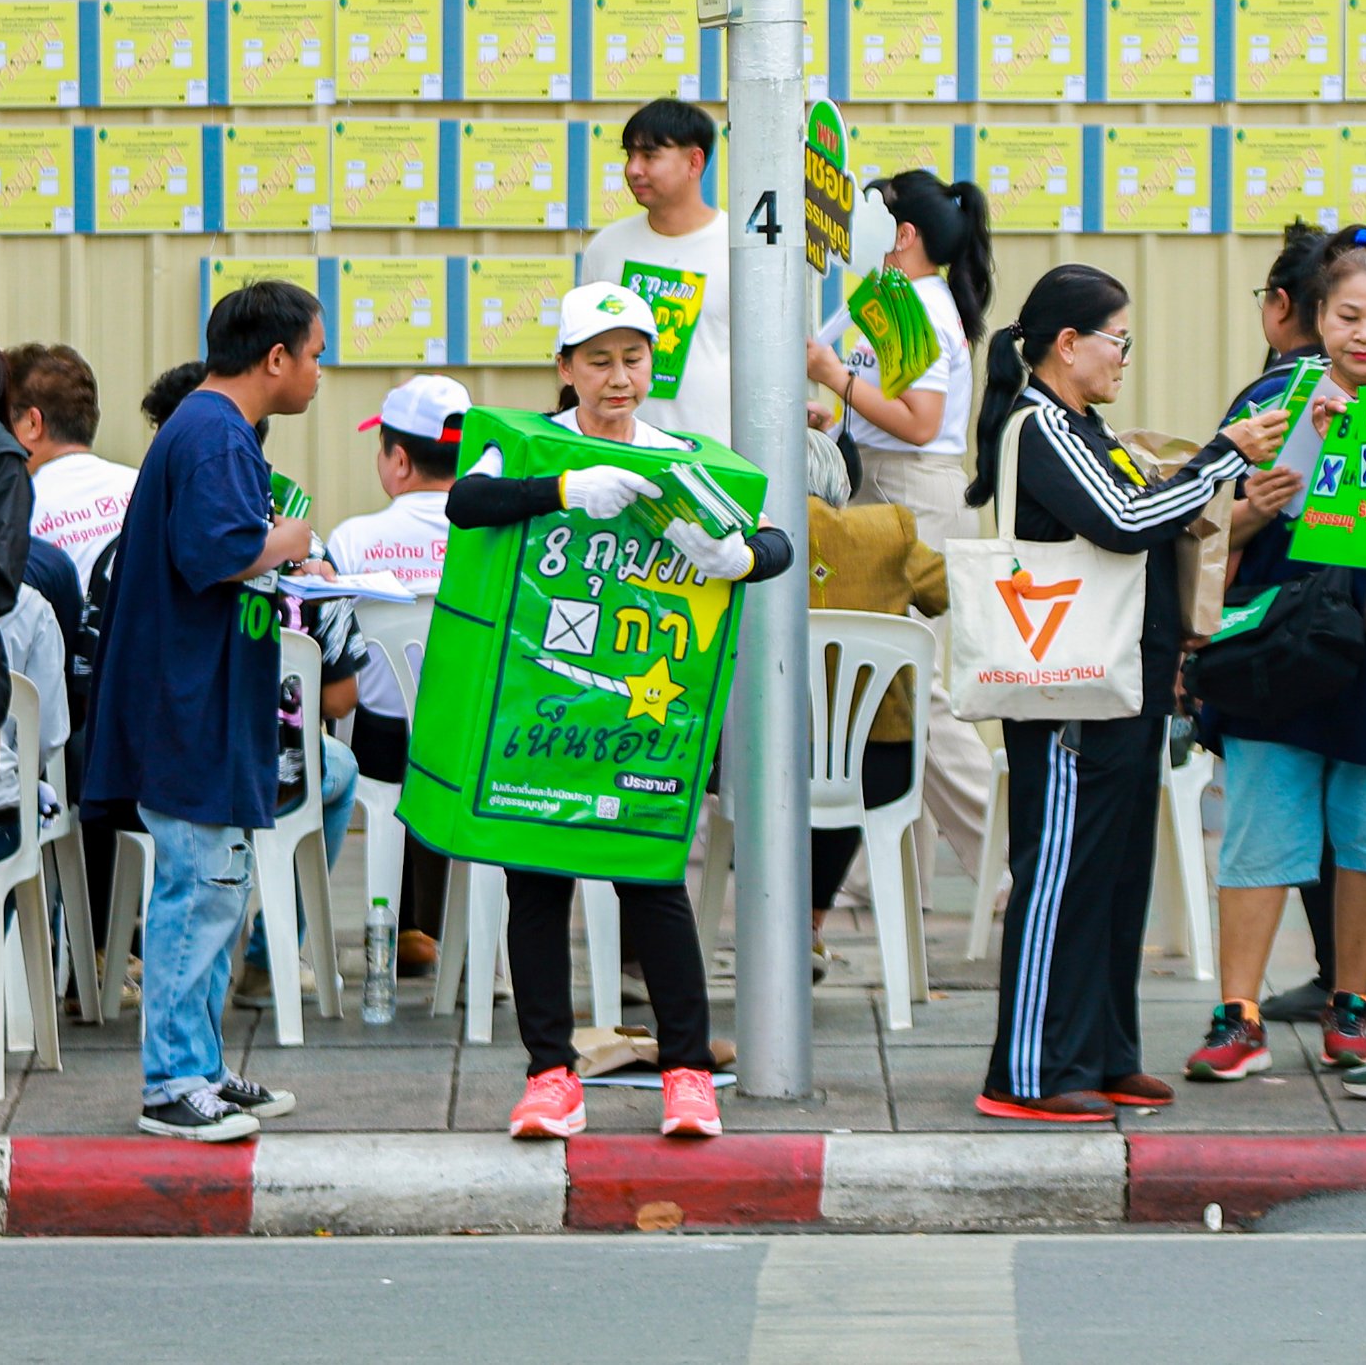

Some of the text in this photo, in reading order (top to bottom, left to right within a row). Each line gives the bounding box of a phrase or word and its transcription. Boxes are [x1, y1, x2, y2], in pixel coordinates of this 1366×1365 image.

[746, 191, 782, 245] 4
[1337, 414, 1350, 439] 8
[35, 508, 91, 535] เพื่อไทย
[365, 539, 424, 560] เพื่อไทย
[539, 527, 571, 576] 8
[614, 607, 690, 660] กา
[978, 663, 1105, 686] พรรคประชาชน
[623, 773, 677, 793] ประชามติ
